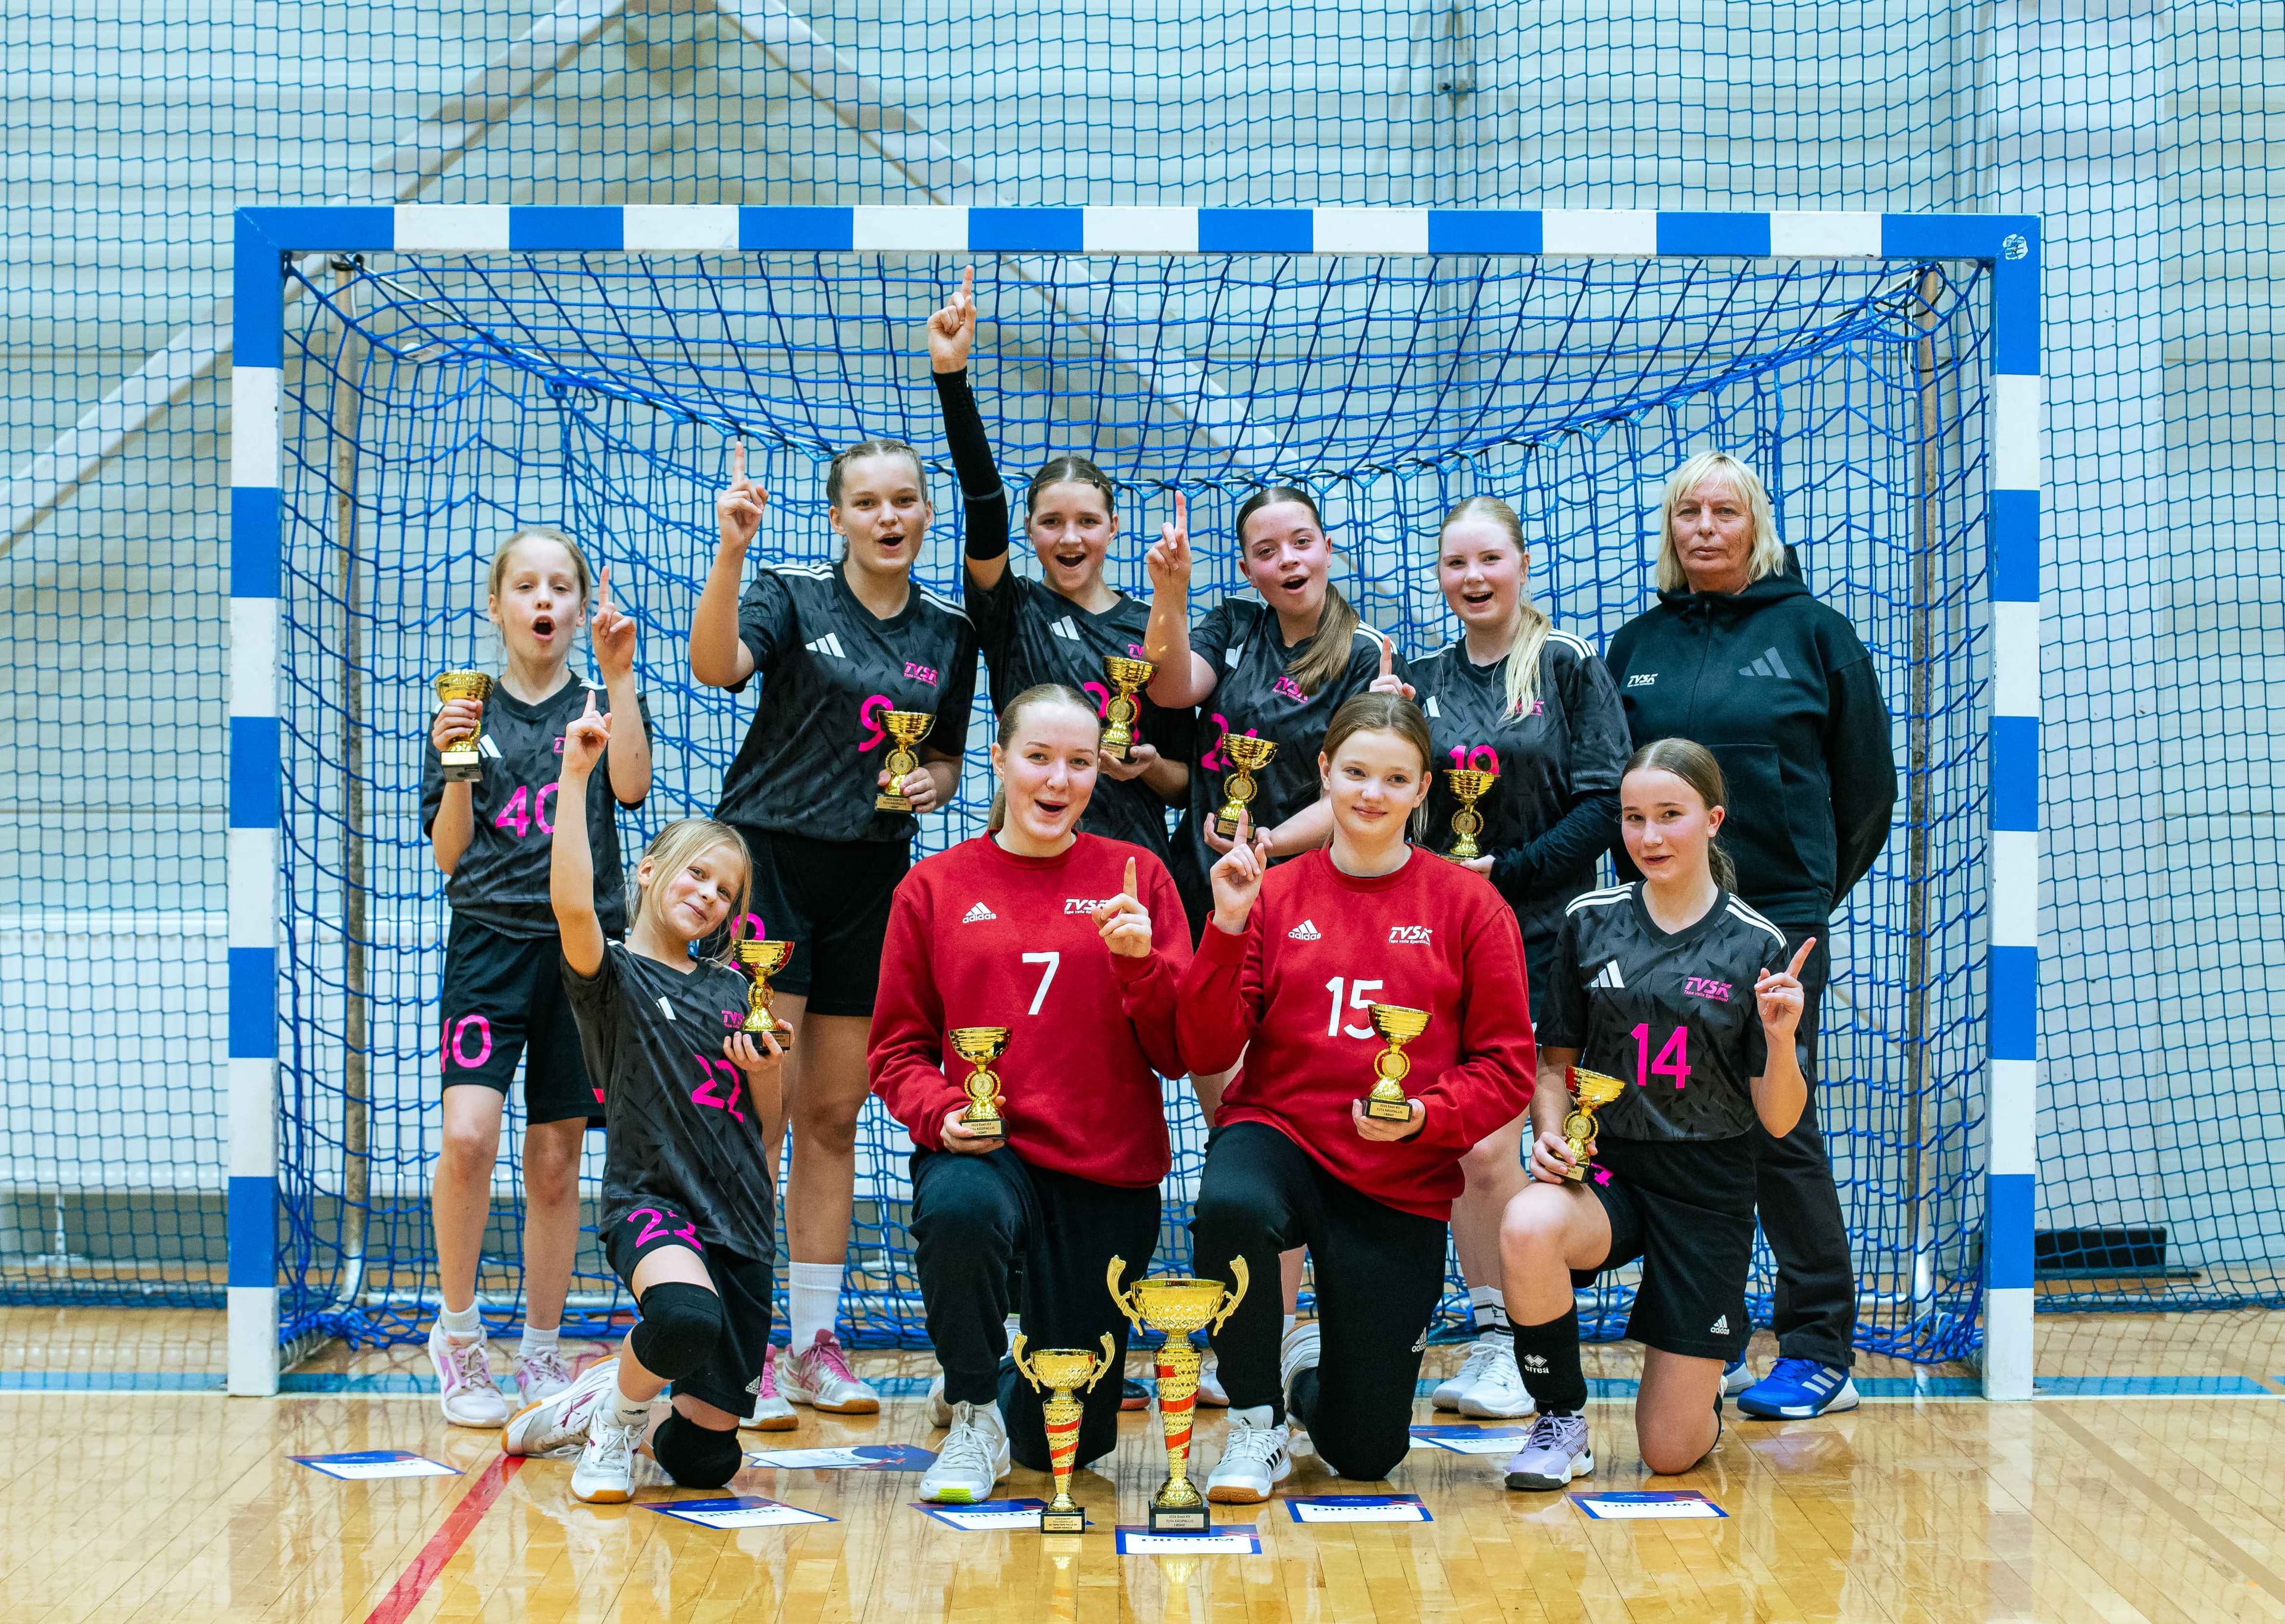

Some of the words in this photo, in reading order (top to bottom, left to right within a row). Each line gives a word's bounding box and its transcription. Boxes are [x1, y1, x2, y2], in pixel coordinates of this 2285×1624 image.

[858, 694, 894, 752] 9
[962, 913, 997, 924] adidas
[1389, 925, 1433, 943] TVSK
[1022, 952, 1060, 1015] 7
[1685, 977, 1732, 998] TVSK
[721, 1009, 743, 1024] TVS
[1325, 976, 1383, 1040] 15
[1630, 1023, 1691, 1089] 14
[1710, 1326, 1730, 1335] adidas
